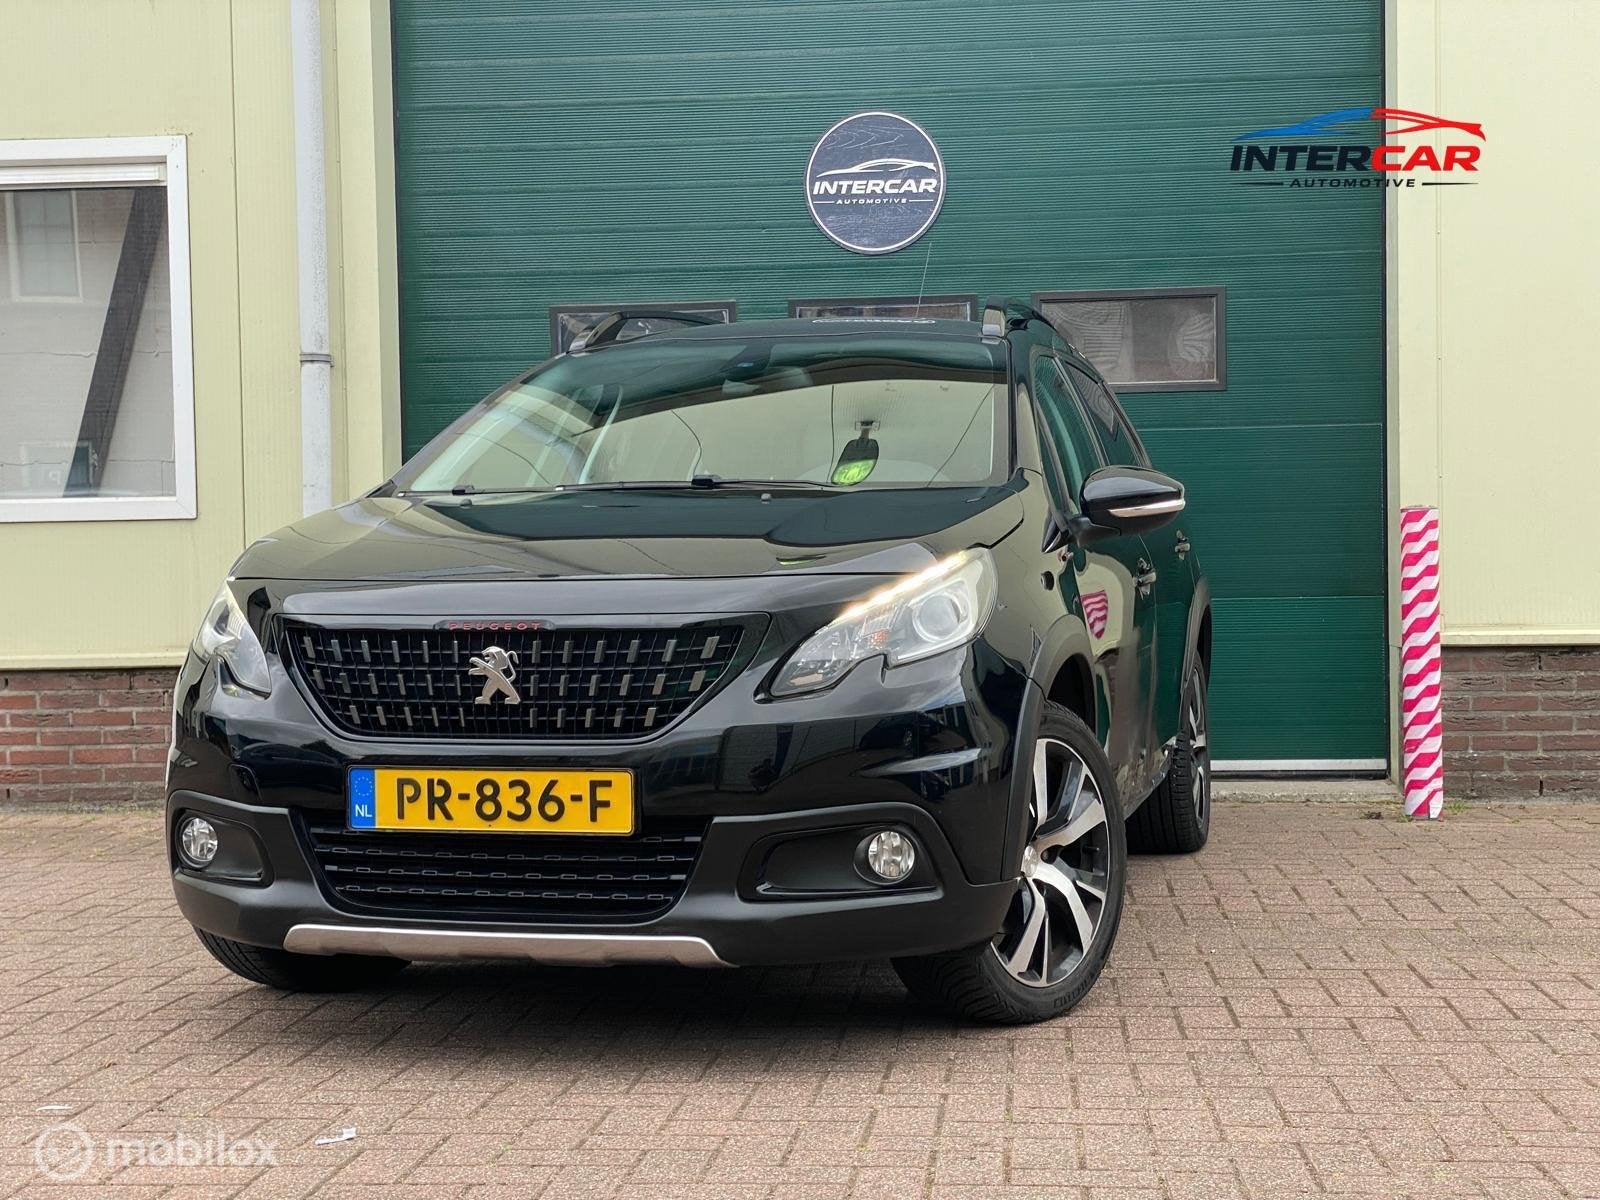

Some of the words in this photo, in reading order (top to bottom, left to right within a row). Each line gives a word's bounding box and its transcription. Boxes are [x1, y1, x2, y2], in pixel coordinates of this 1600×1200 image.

[813, 178, 937, 195] INTERCAR
[448, 621, 541, 631] PEUGEOT
[396, 777, 613, 823] PR-836-F
[355, 804, 372, 818] NL
